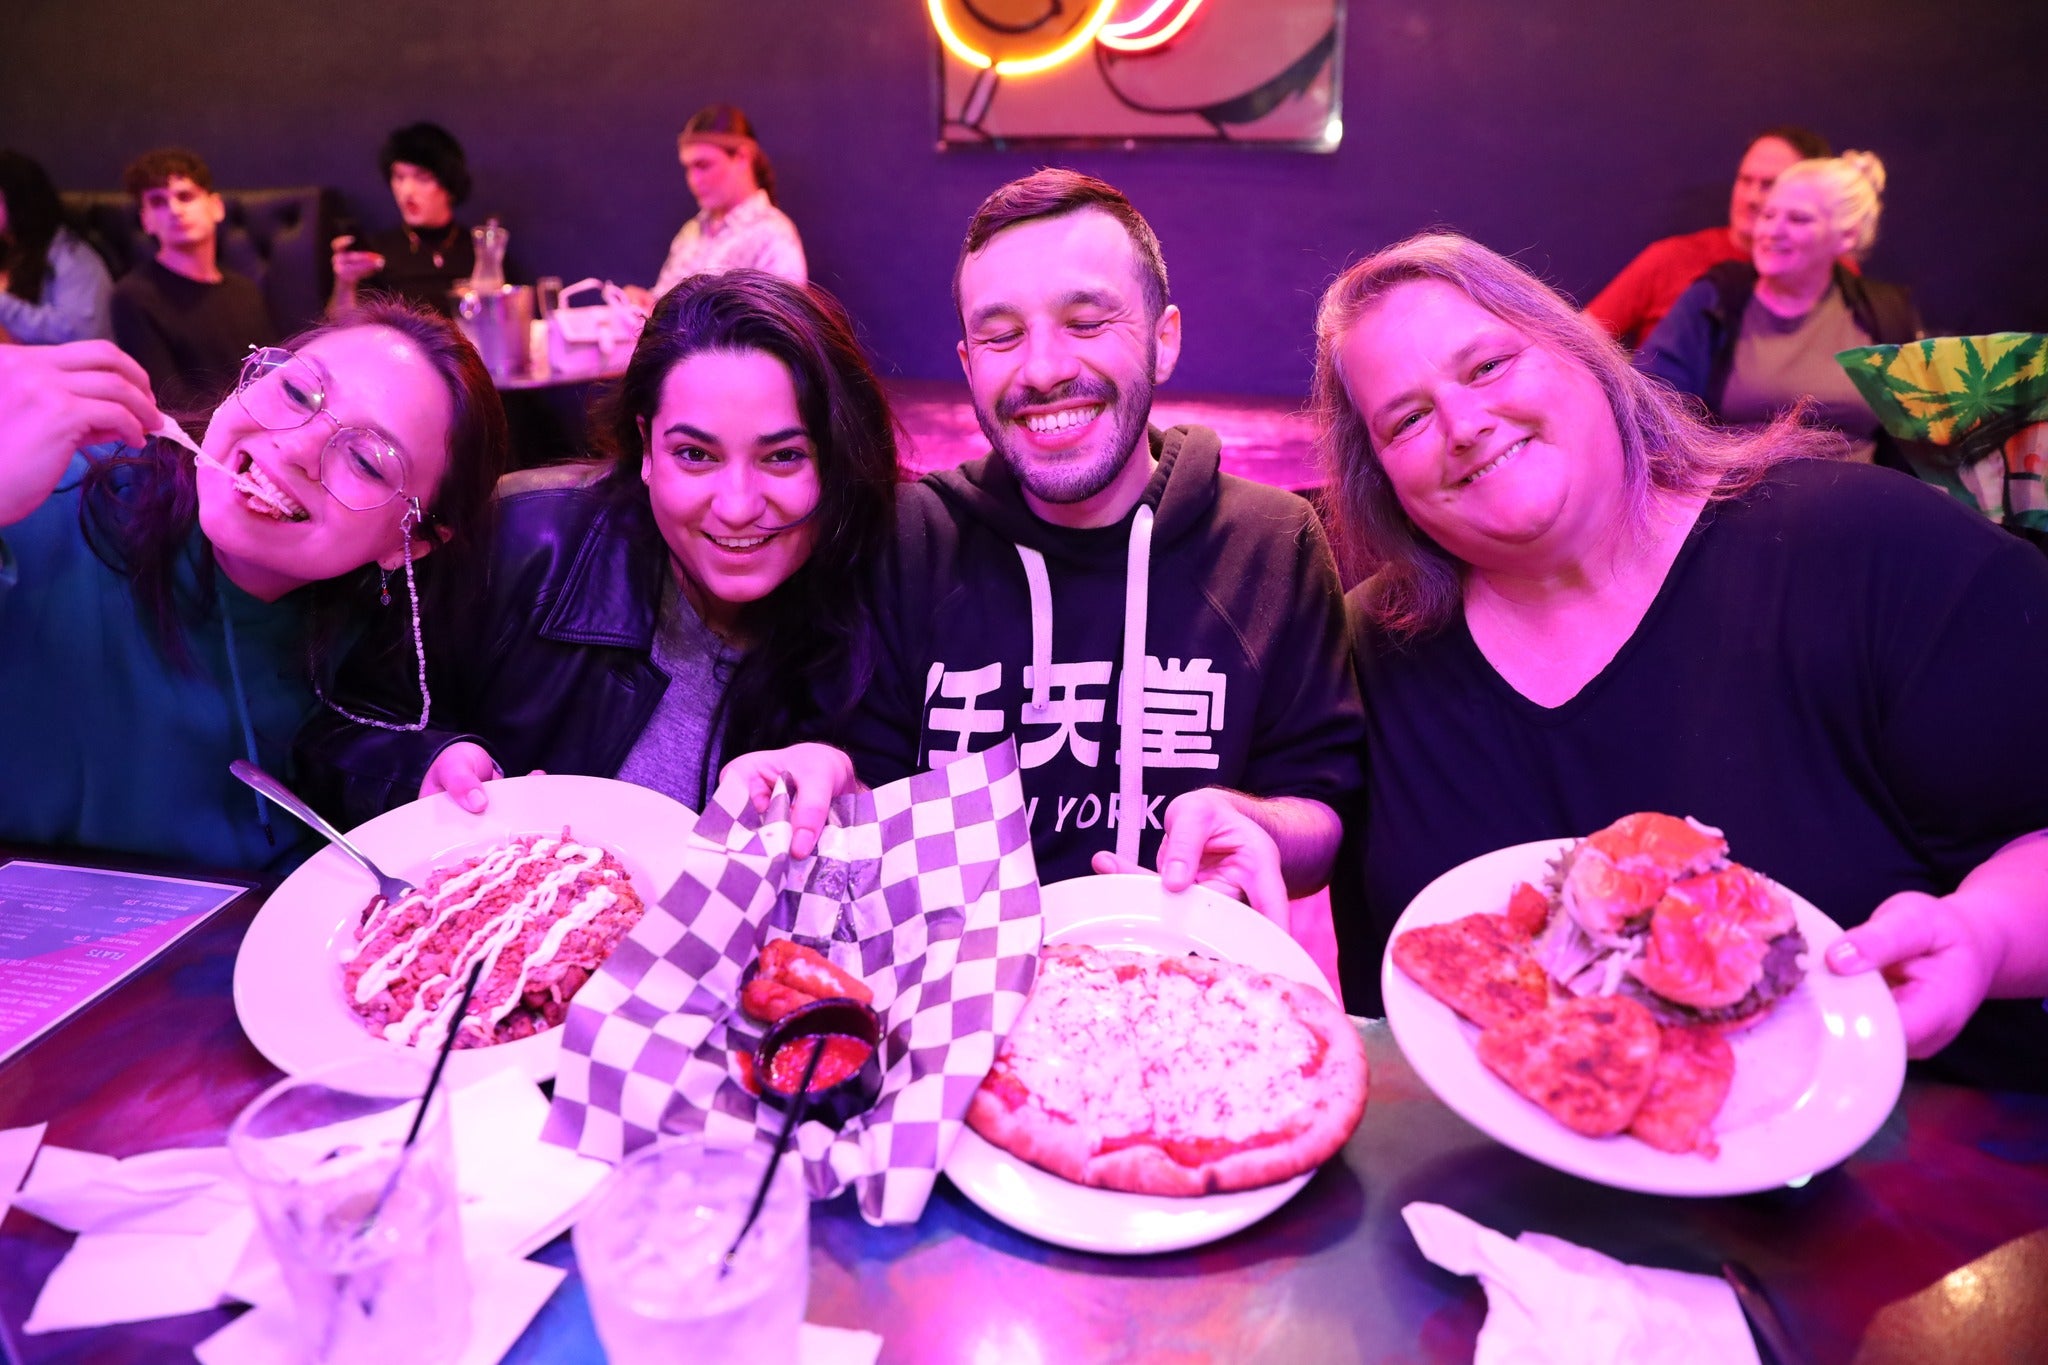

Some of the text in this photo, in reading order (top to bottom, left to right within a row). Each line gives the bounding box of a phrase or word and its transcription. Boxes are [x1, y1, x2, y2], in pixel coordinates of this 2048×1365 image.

[916, 655, 1227, 769] 任天堂
[85, 948, 127, 960] FLATS
